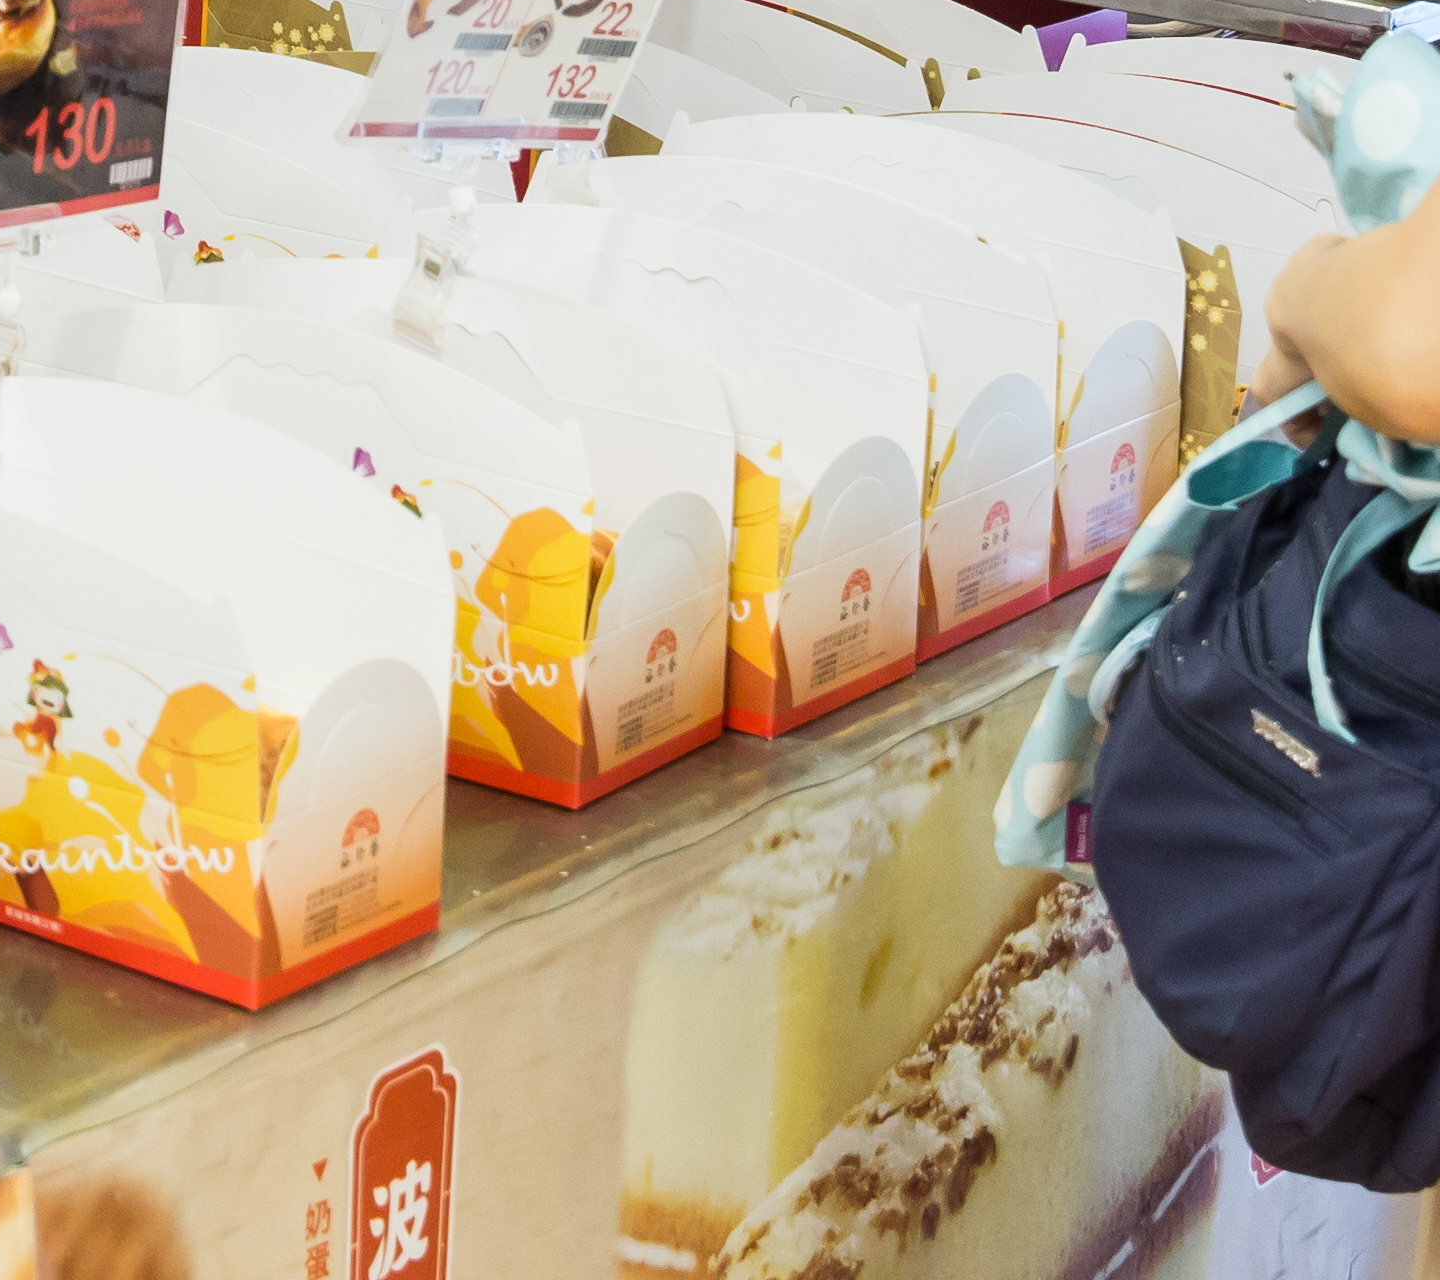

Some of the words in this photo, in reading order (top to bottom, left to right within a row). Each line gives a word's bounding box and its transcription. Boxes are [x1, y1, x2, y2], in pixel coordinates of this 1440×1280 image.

[593, 0, 633, 37] 22
[426, 58, 476, 96] 120
[545, 62, 598, 100] 132
[25, 97, 117, 176] 130
[304, 1199, 333, 1280] 奶蛋
[368, 1159, 431, 1279] 波
